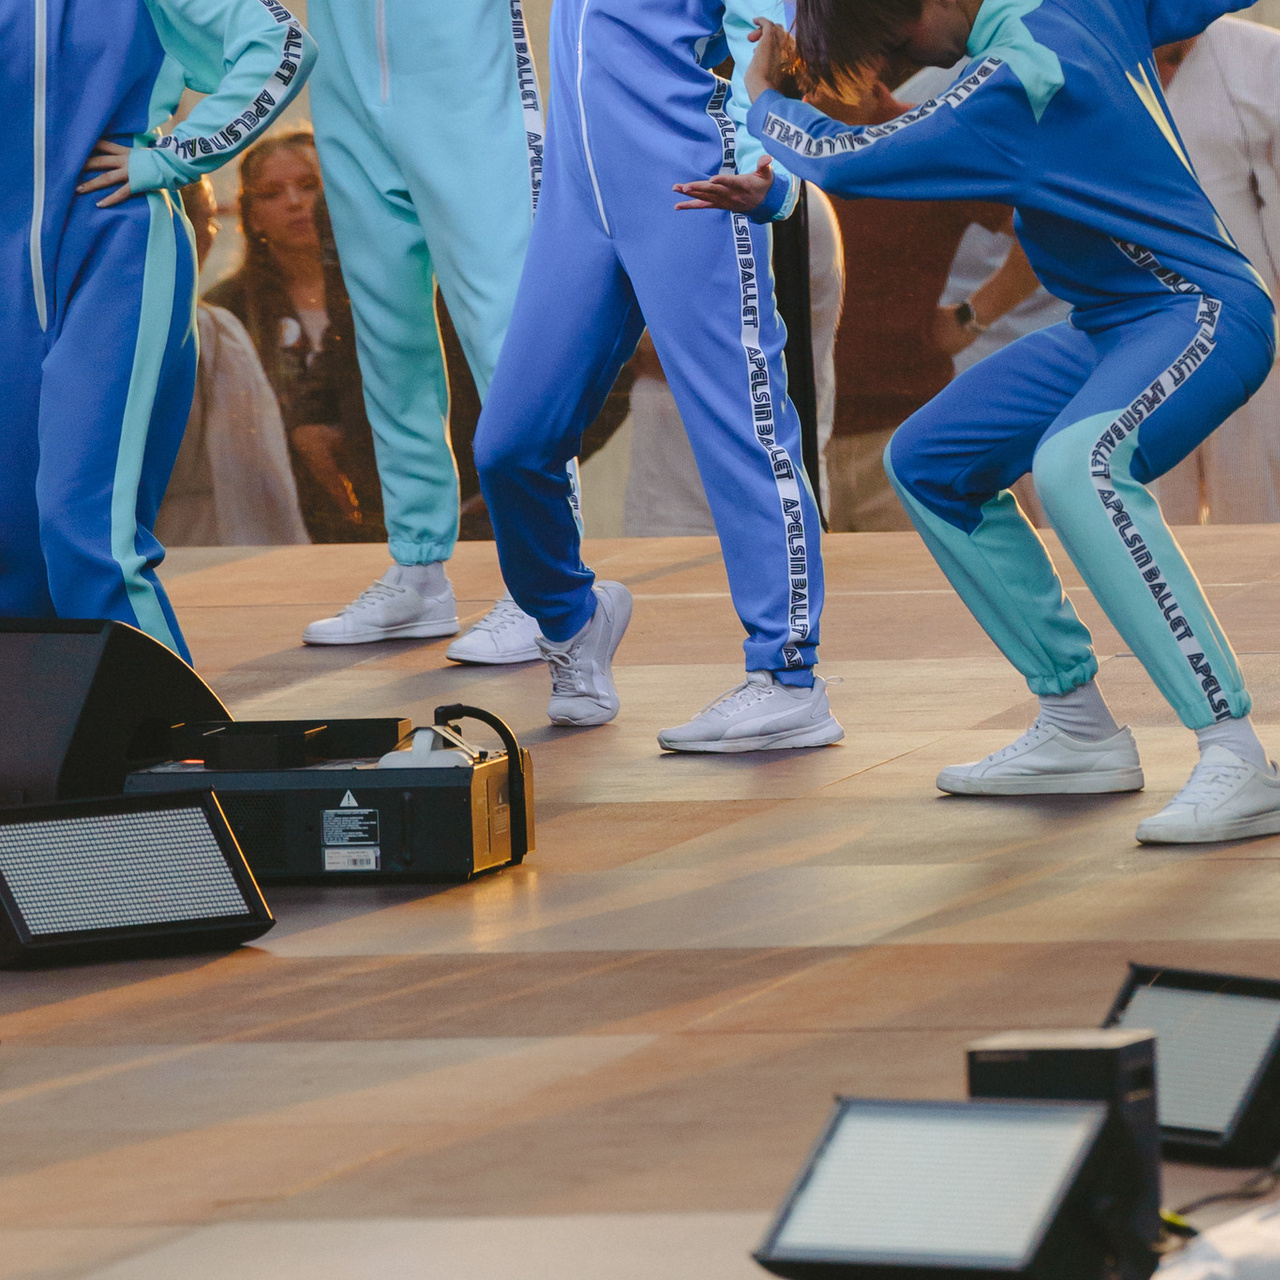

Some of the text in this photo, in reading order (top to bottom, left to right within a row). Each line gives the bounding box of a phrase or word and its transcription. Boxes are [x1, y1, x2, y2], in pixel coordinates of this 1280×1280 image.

[275, 21, 302, 86] ALLET
[514, 42, 540, 111] BALLET
[209, 89, 276, 150] APELSIN
[764, 115, 804, 150] APELSI
[732, 211, 752, 255] LSIN
[738, 258, 758, 328] BALLET
[745, 345, 773, 422] APELSIN
[1167, 338, 1210, 387] BALLET
[1118, 379, 1166, 432] APELSIN
[756, 424, 794, 480] BALET
[1091, 423, 1126, 479] BALLET
[782, 497, 807, 575] APELSIN
[1097, 488, 1152, 569] APELSIN
[790, 578, 809, 639] BALLT
[1142, 568, 1194, 641] BALLET
[1187, 652, 1232, 722] APELSI
